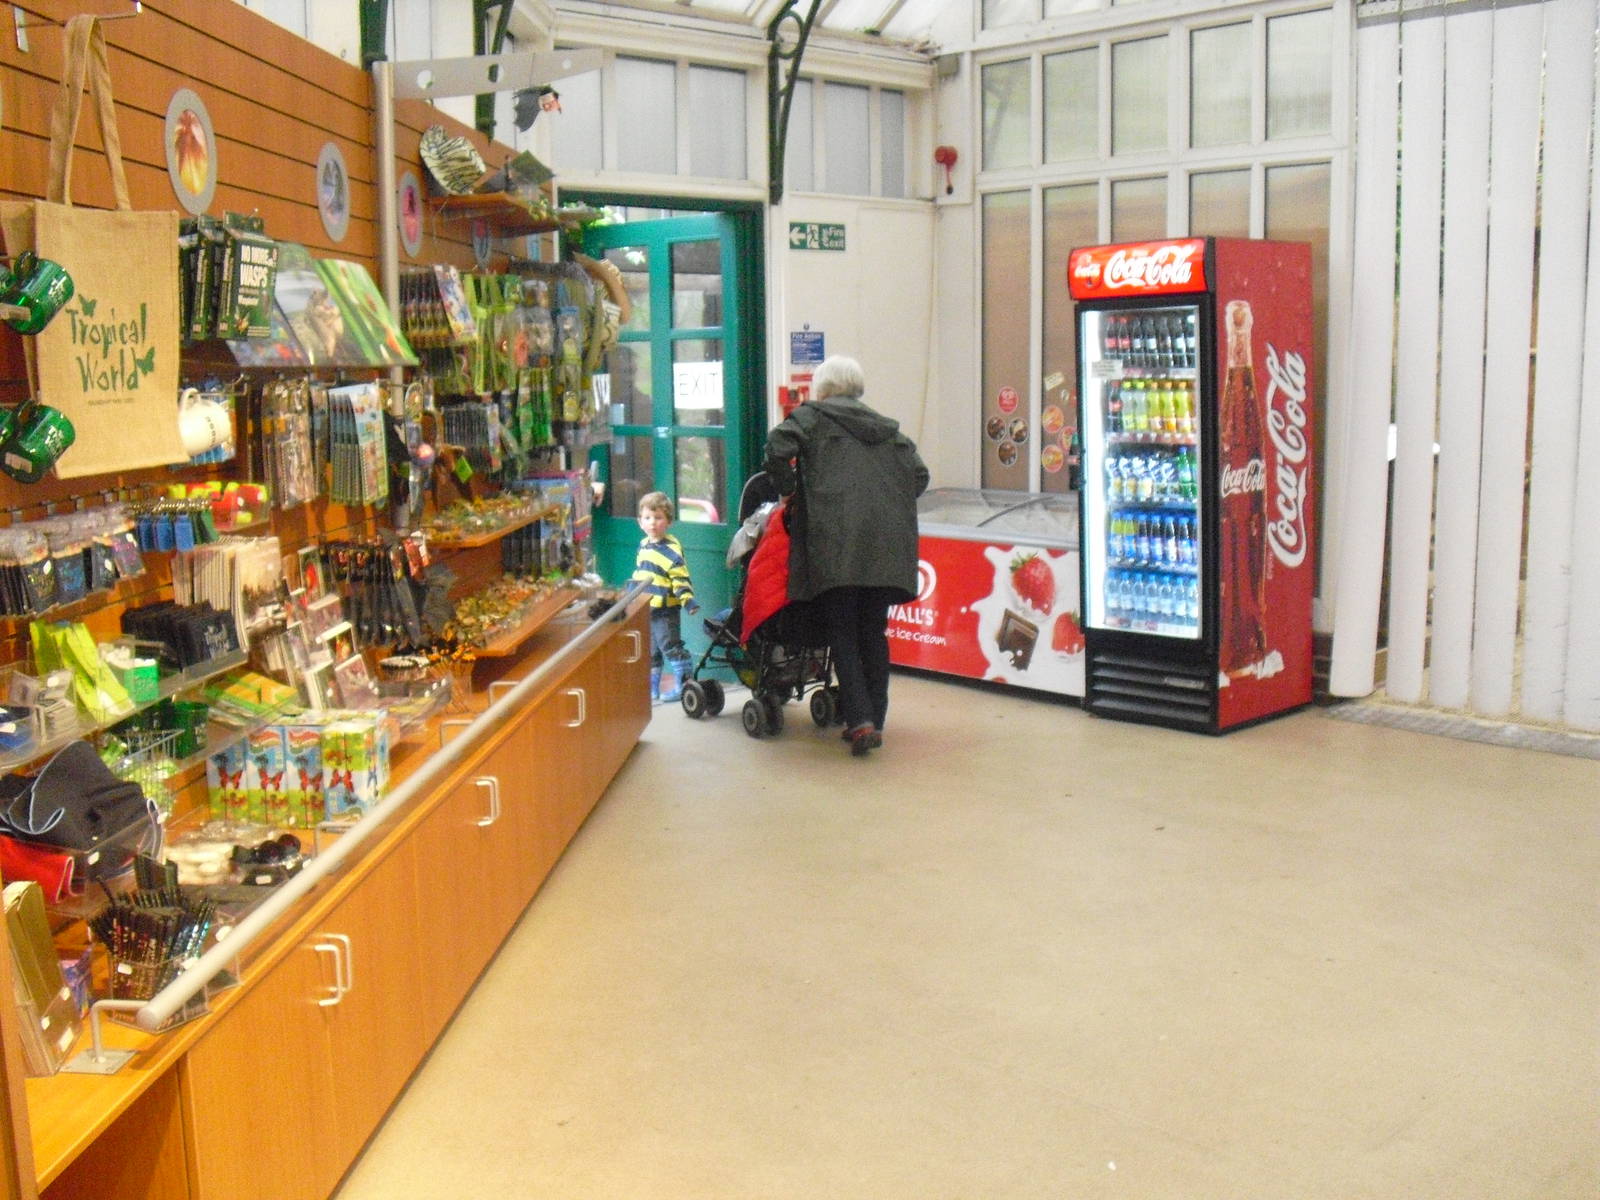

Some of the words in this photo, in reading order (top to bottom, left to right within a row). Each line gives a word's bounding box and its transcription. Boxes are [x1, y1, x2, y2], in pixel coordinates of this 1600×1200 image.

[240, 263, 269, 288] WASPS
[1103, 244, 1196, 289] Coca-Cola
[65, 302, 147, 359] Tropical
[76, 347, 139, 392] World
[679, 372, 719, 396] EXIT
[1266, 342, 1307, 568] Coca-Cola
[913, 632, 946, 646] cream
